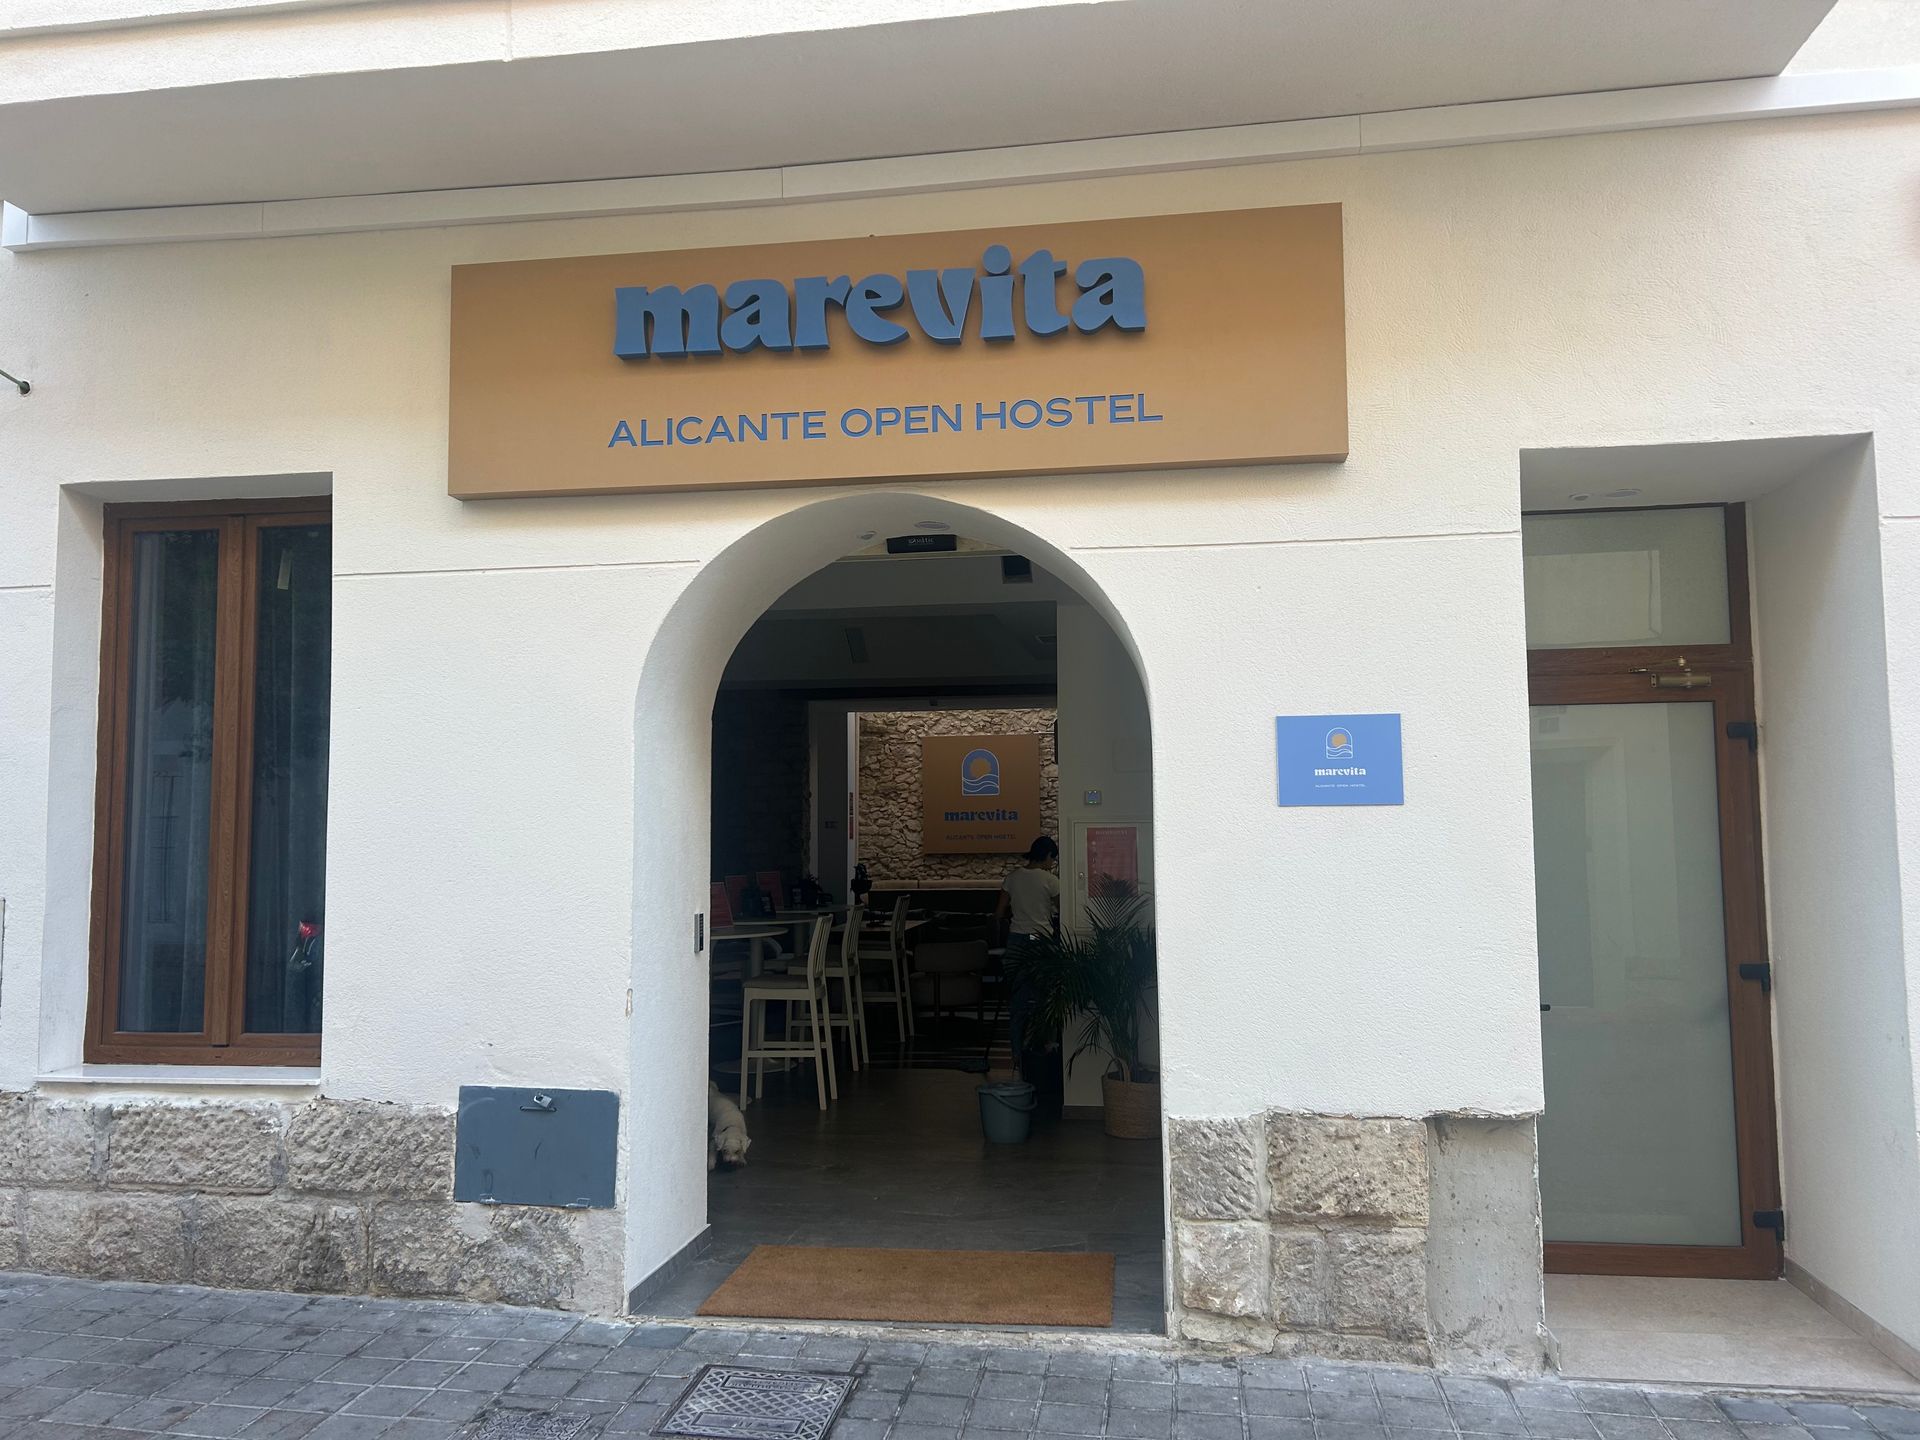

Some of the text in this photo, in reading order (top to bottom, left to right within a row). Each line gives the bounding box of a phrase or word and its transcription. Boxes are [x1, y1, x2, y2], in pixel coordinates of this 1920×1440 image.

[614, 244, 1147, 359] marevita
[608, 393, 1164, 448] ALICANTE OPEN HOSTEL
[1314, 767, 1366, 776] marevita
[944, 808, 1018, 821] marevita
